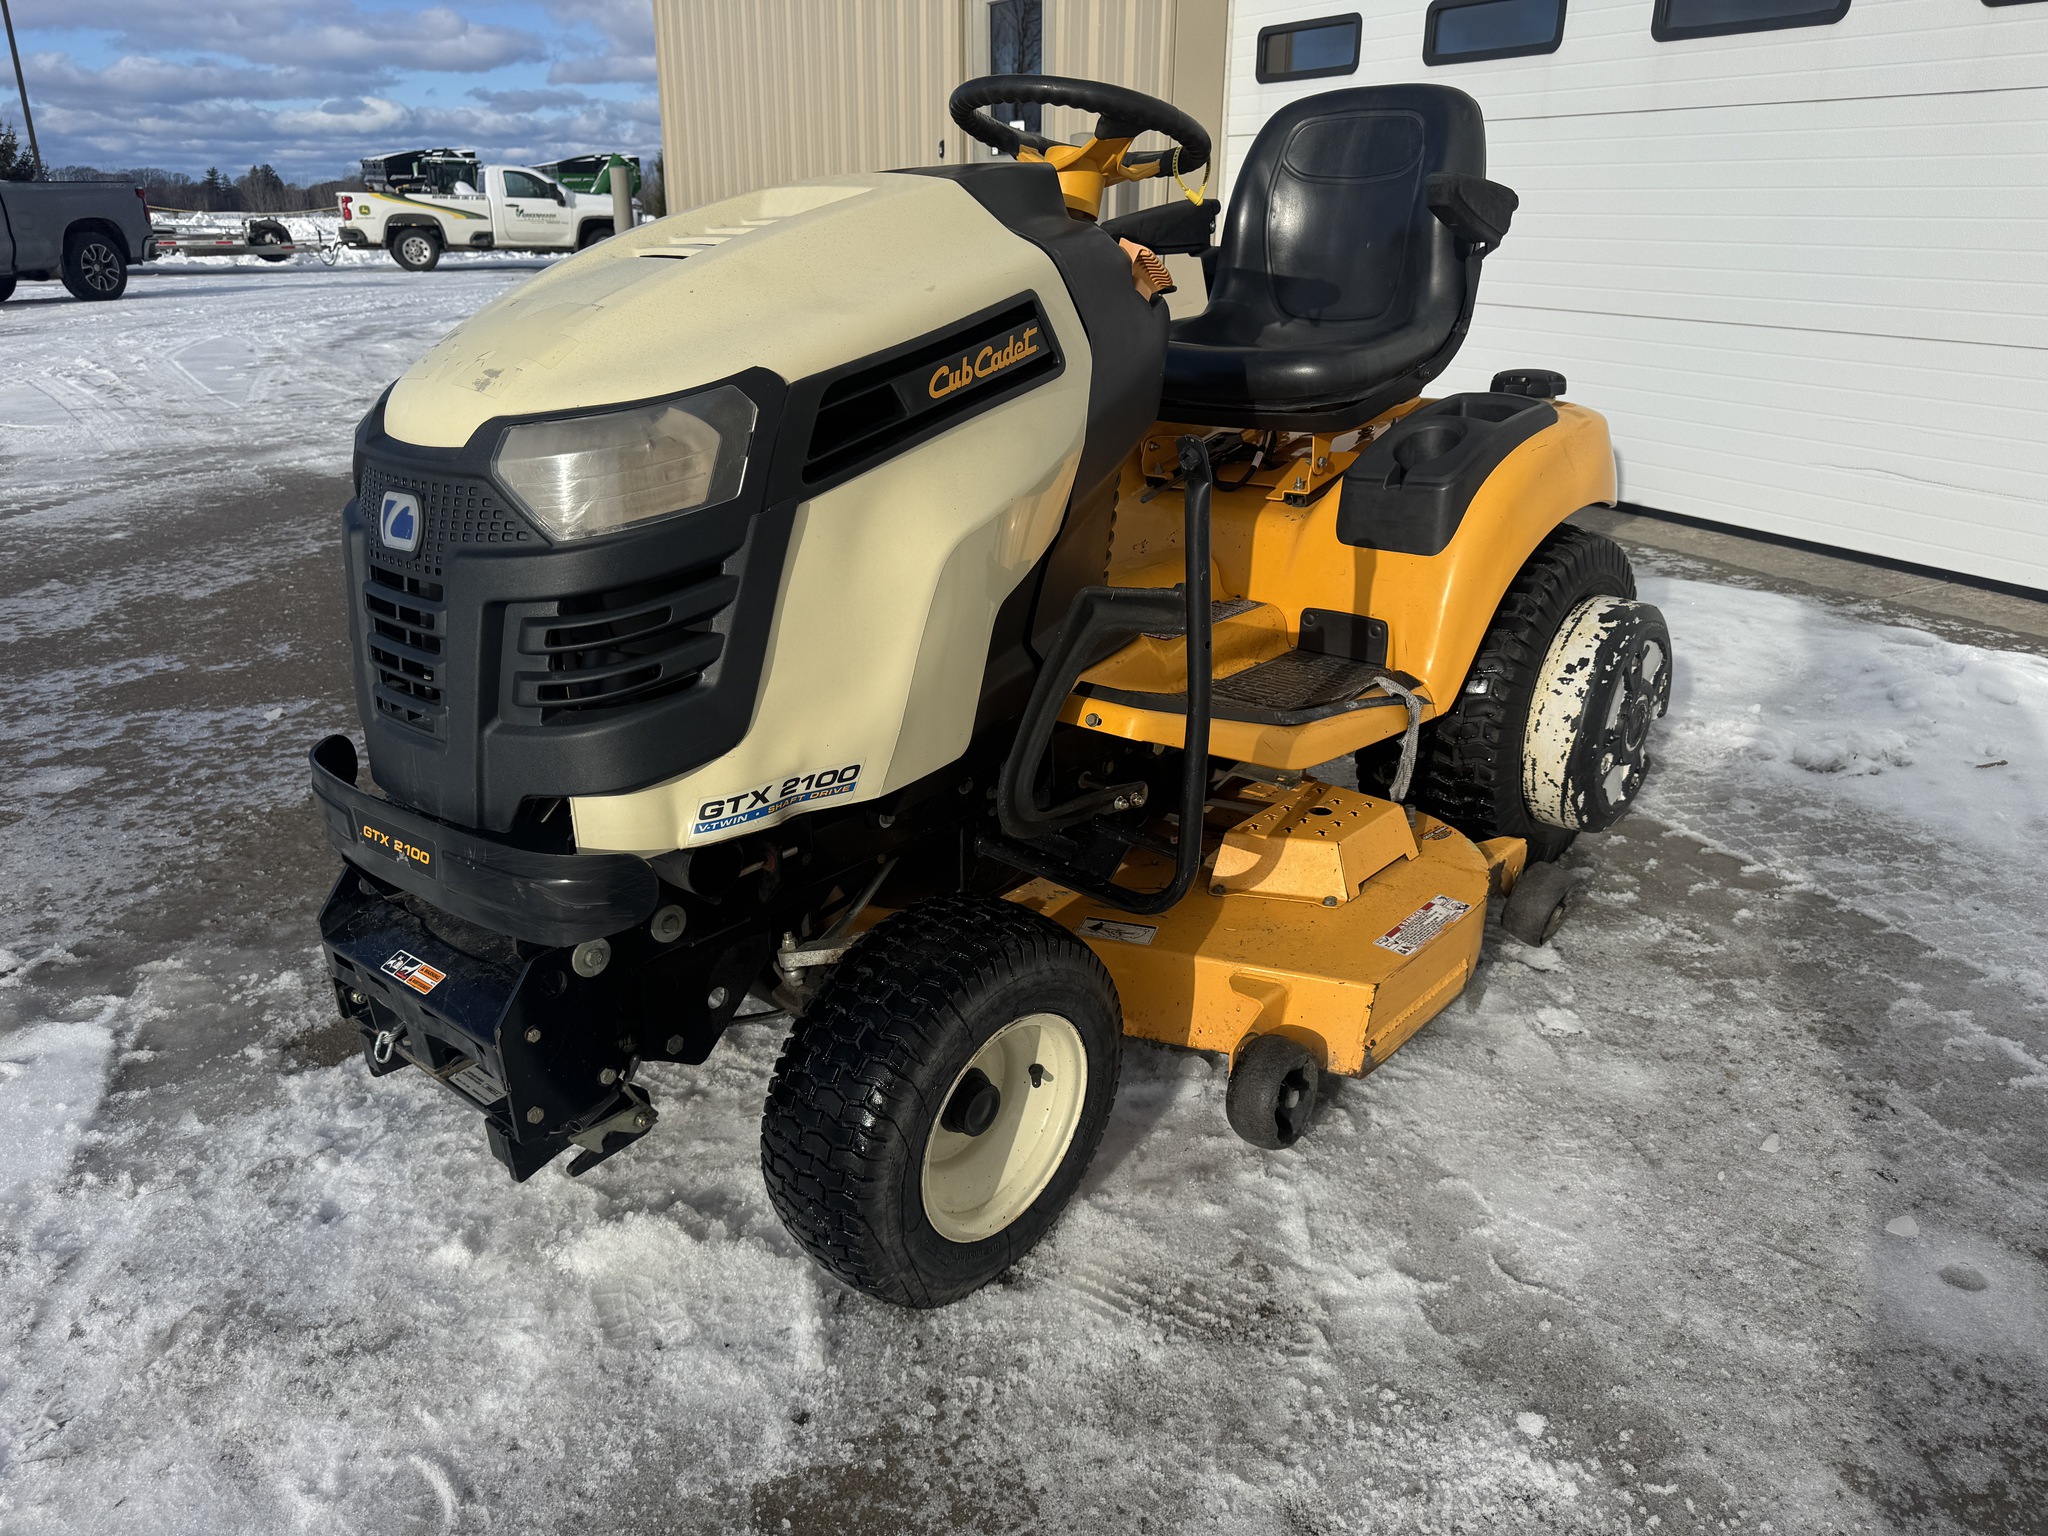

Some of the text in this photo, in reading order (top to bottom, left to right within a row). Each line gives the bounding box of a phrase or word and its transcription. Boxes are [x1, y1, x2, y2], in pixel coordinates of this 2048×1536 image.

[928, 326, 1038, 399] Cub Cadet
[698, 764, 861, 821] GTX 2100
[698, 785, 851, 832] V-TWIN SHAFT DRIVE
[363, 825, 430, 865] GTX 2100
